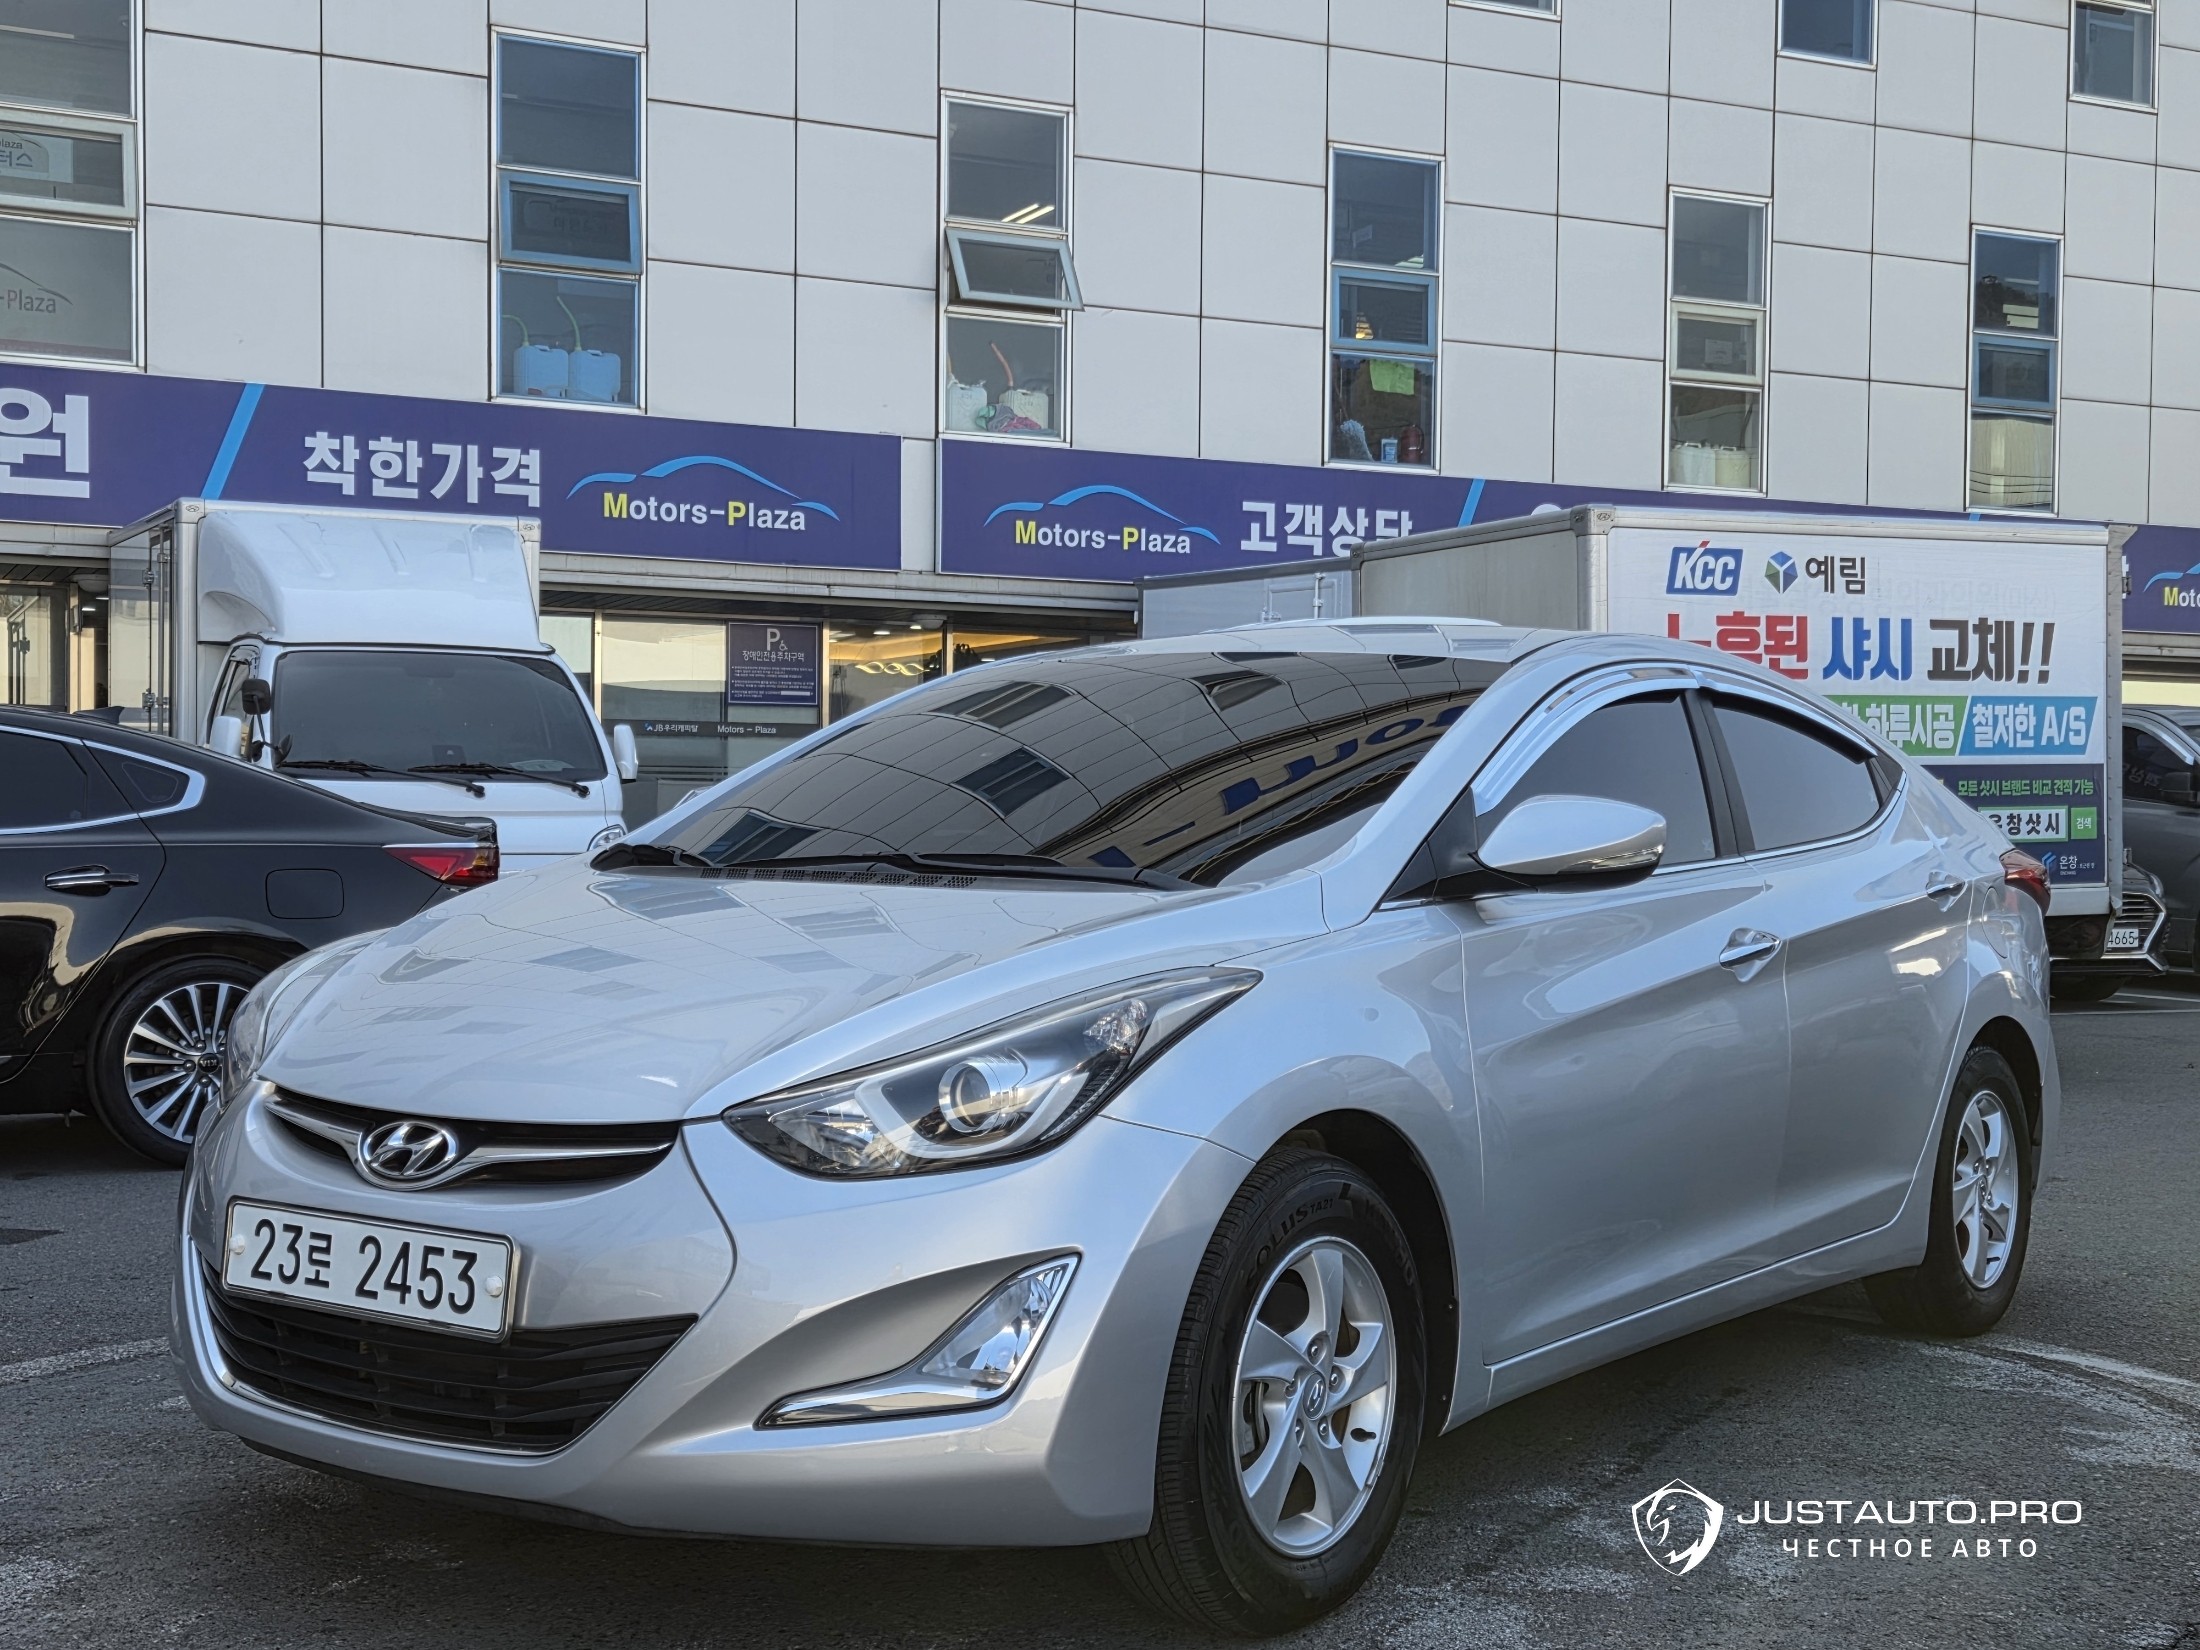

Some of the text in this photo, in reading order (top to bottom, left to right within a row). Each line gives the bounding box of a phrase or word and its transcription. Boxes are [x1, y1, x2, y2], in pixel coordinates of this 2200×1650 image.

[303, 431, 541, 508] 착한가격
[603, 492, 806, 531] Motors-Plaza
[1015, 520, 1191, 554] Motors-Plaza
[1673, 541, 1736, 591] KCC
[1805, 555, 1866, 594] 예림
[766, 628, 780, 651] P
[1823, 616, 1913, 681] 샤시
[1927, 617, 2056, 684] 교체!!
[717, 724, 744, 734] Motors
[755, 726, 777, 734] Plaza
[1972, 703, 2087, 748] 철저한 A/S
[1958, 780, 1978, 796] 모든
[2001, 780, 2031, 796] 브랜드
[2032, 780, 2052, 796] 비교
[2053, 780, 2073, 796] 견적
[2074, 779, 2094, 796] 가능
[2076, 817, 2092, 830] 검색
[2059, 855, 2078, 870] 온창
[2108, 930, 2135, 946] 4665
[250, 1218, 478, 1315] 23로 2453
